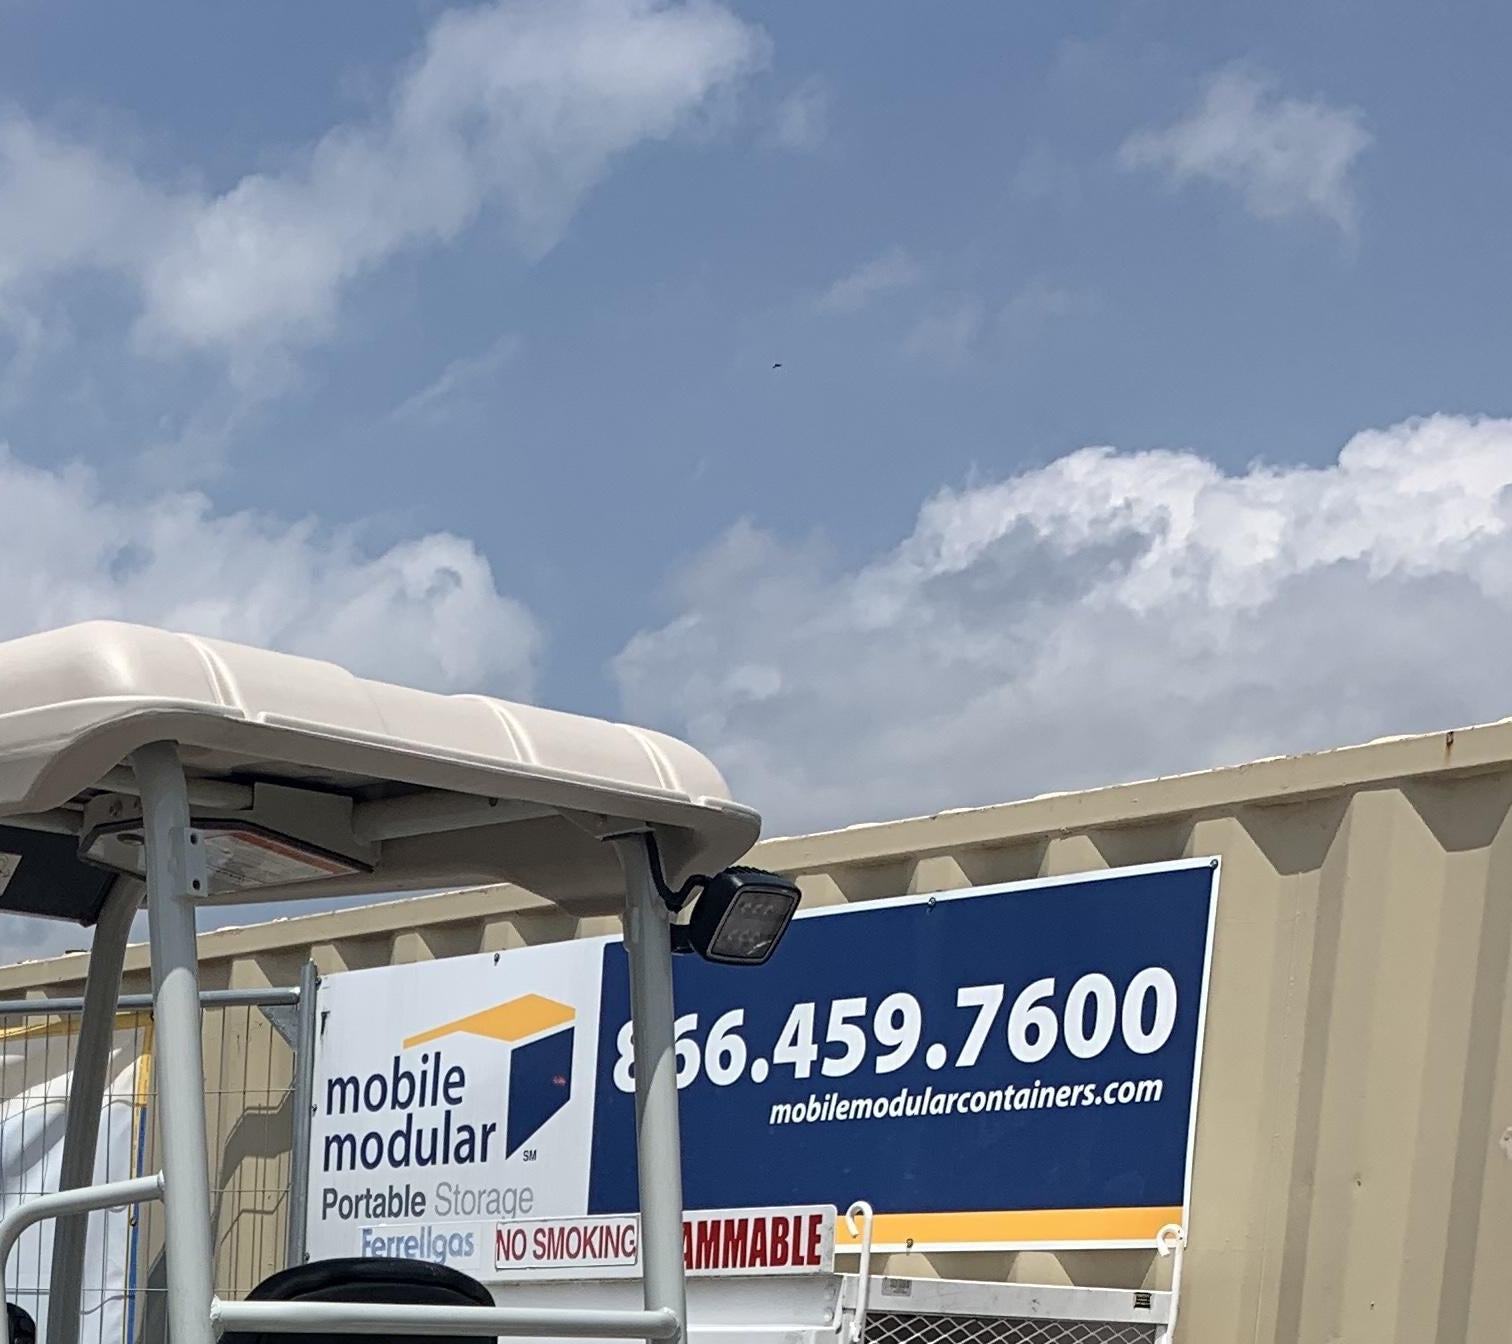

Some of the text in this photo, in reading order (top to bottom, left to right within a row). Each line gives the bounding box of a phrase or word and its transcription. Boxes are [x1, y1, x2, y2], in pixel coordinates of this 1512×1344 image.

[612, 966, 1178, 1094] 866.459.7600
[325, 1051, 466, 1116] mobile
[768, 1076, 1163, 1125] mobilemodularcontainers.com
[322, 1110, 497, 1173] modular
[321, 1181, 534, 1221] Portable Storage
[361, 1226, 475, 1266] Ferrellgas
[496, 1224, 637, 1262] NO SMOKING
[682, 1213, 823, 1270] AMMABLE
